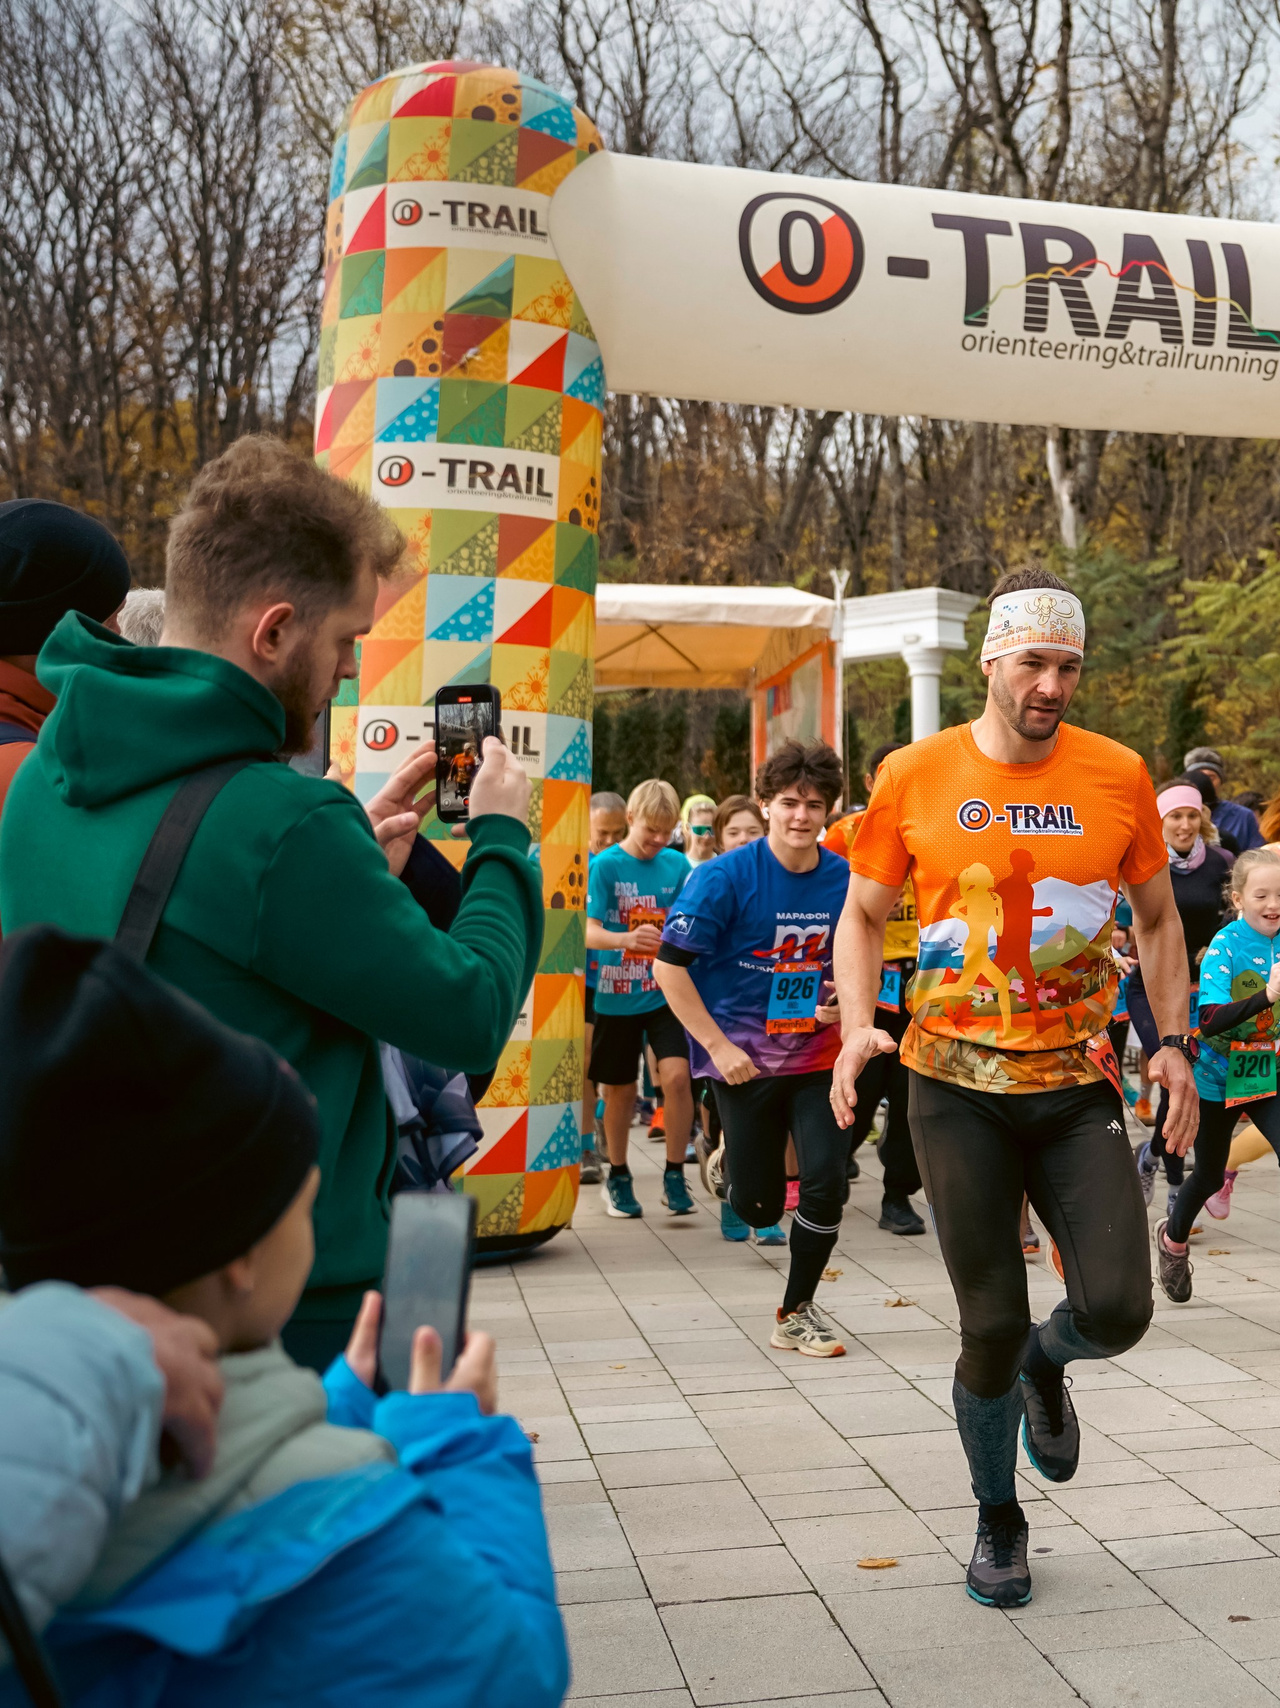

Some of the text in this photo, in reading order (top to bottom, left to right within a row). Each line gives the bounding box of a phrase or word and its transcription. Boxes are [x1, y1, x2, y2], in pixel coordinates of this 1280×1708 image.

[960, 330, 1280, 381] orienteering&trailrunning
[614, 881, 639, 896] 2024
[776, 912, 830, 920] МАРАФОН
[775, 976, 816, 1001] 926
[1233, 1054, 1271, 1078] 320
